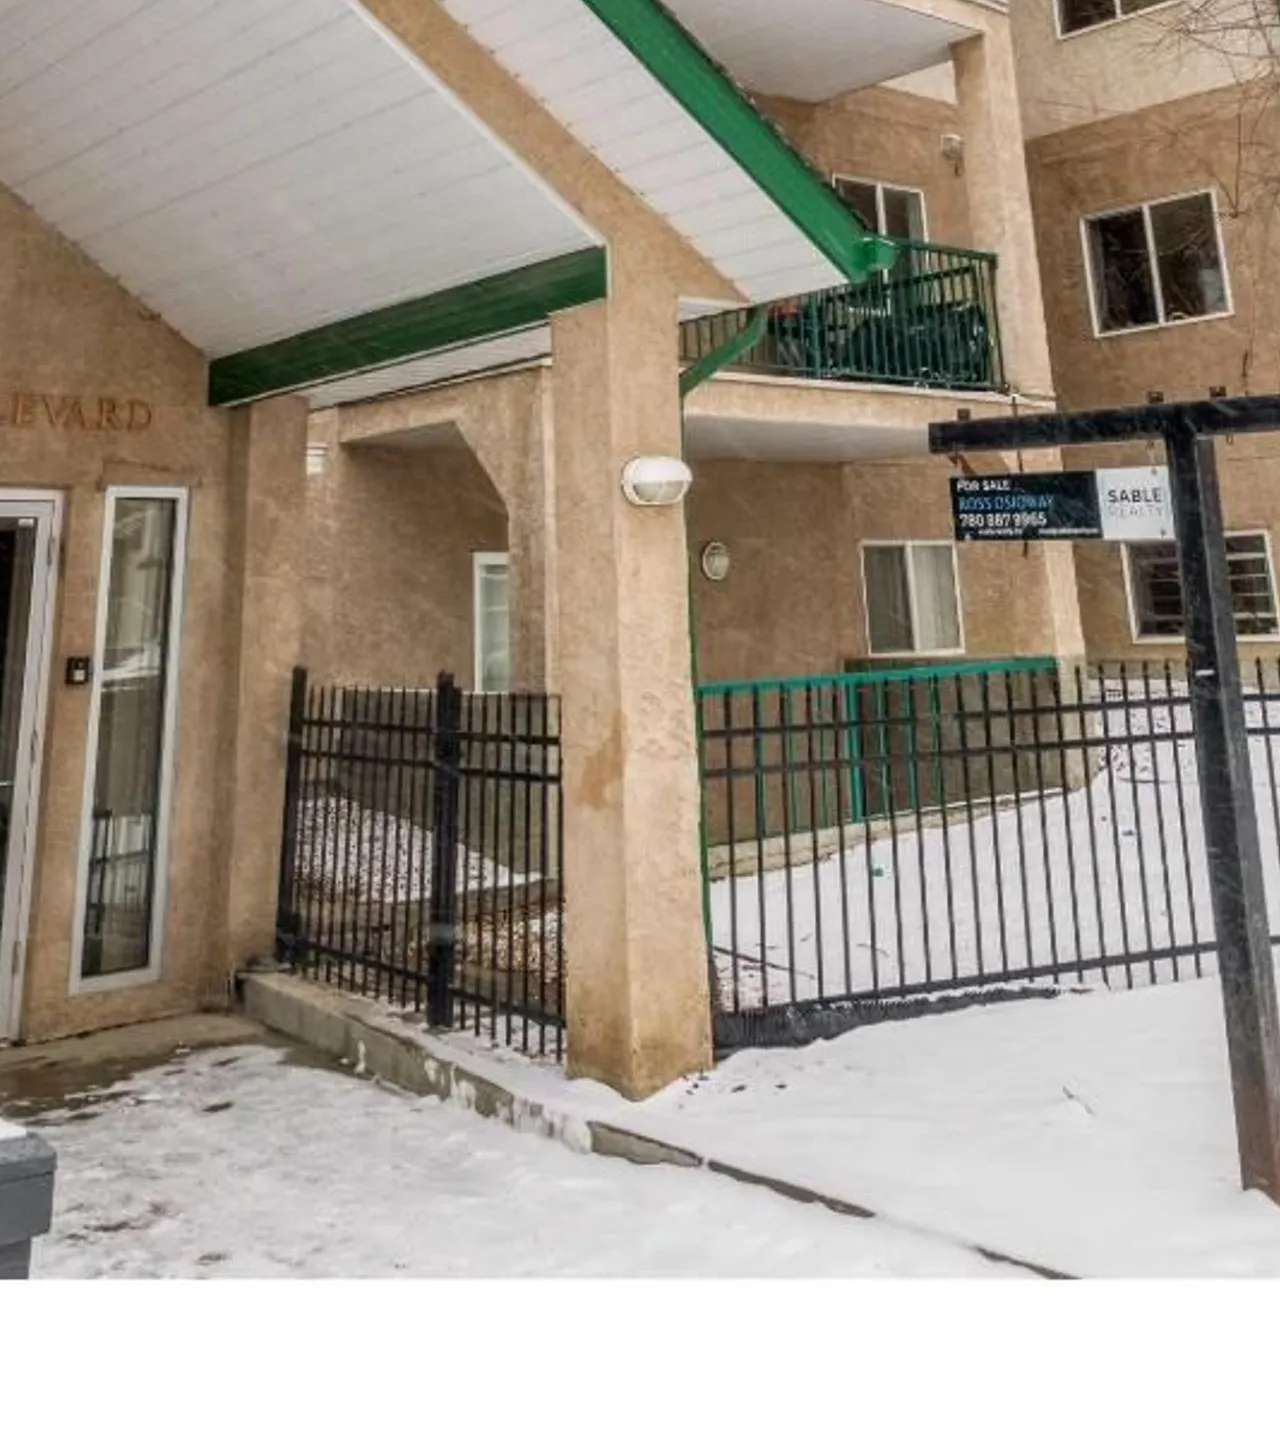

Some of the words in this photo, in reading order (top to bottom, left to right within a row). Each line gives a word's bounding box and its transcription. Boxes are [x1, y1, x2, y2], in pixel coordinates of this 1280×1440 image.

[957, 480, 980, 493] FOR
[983, 479, 1011, 491] SALE
[1107, 487, 1162, 503] SABLE
[960, 513, 985, 528] 780
